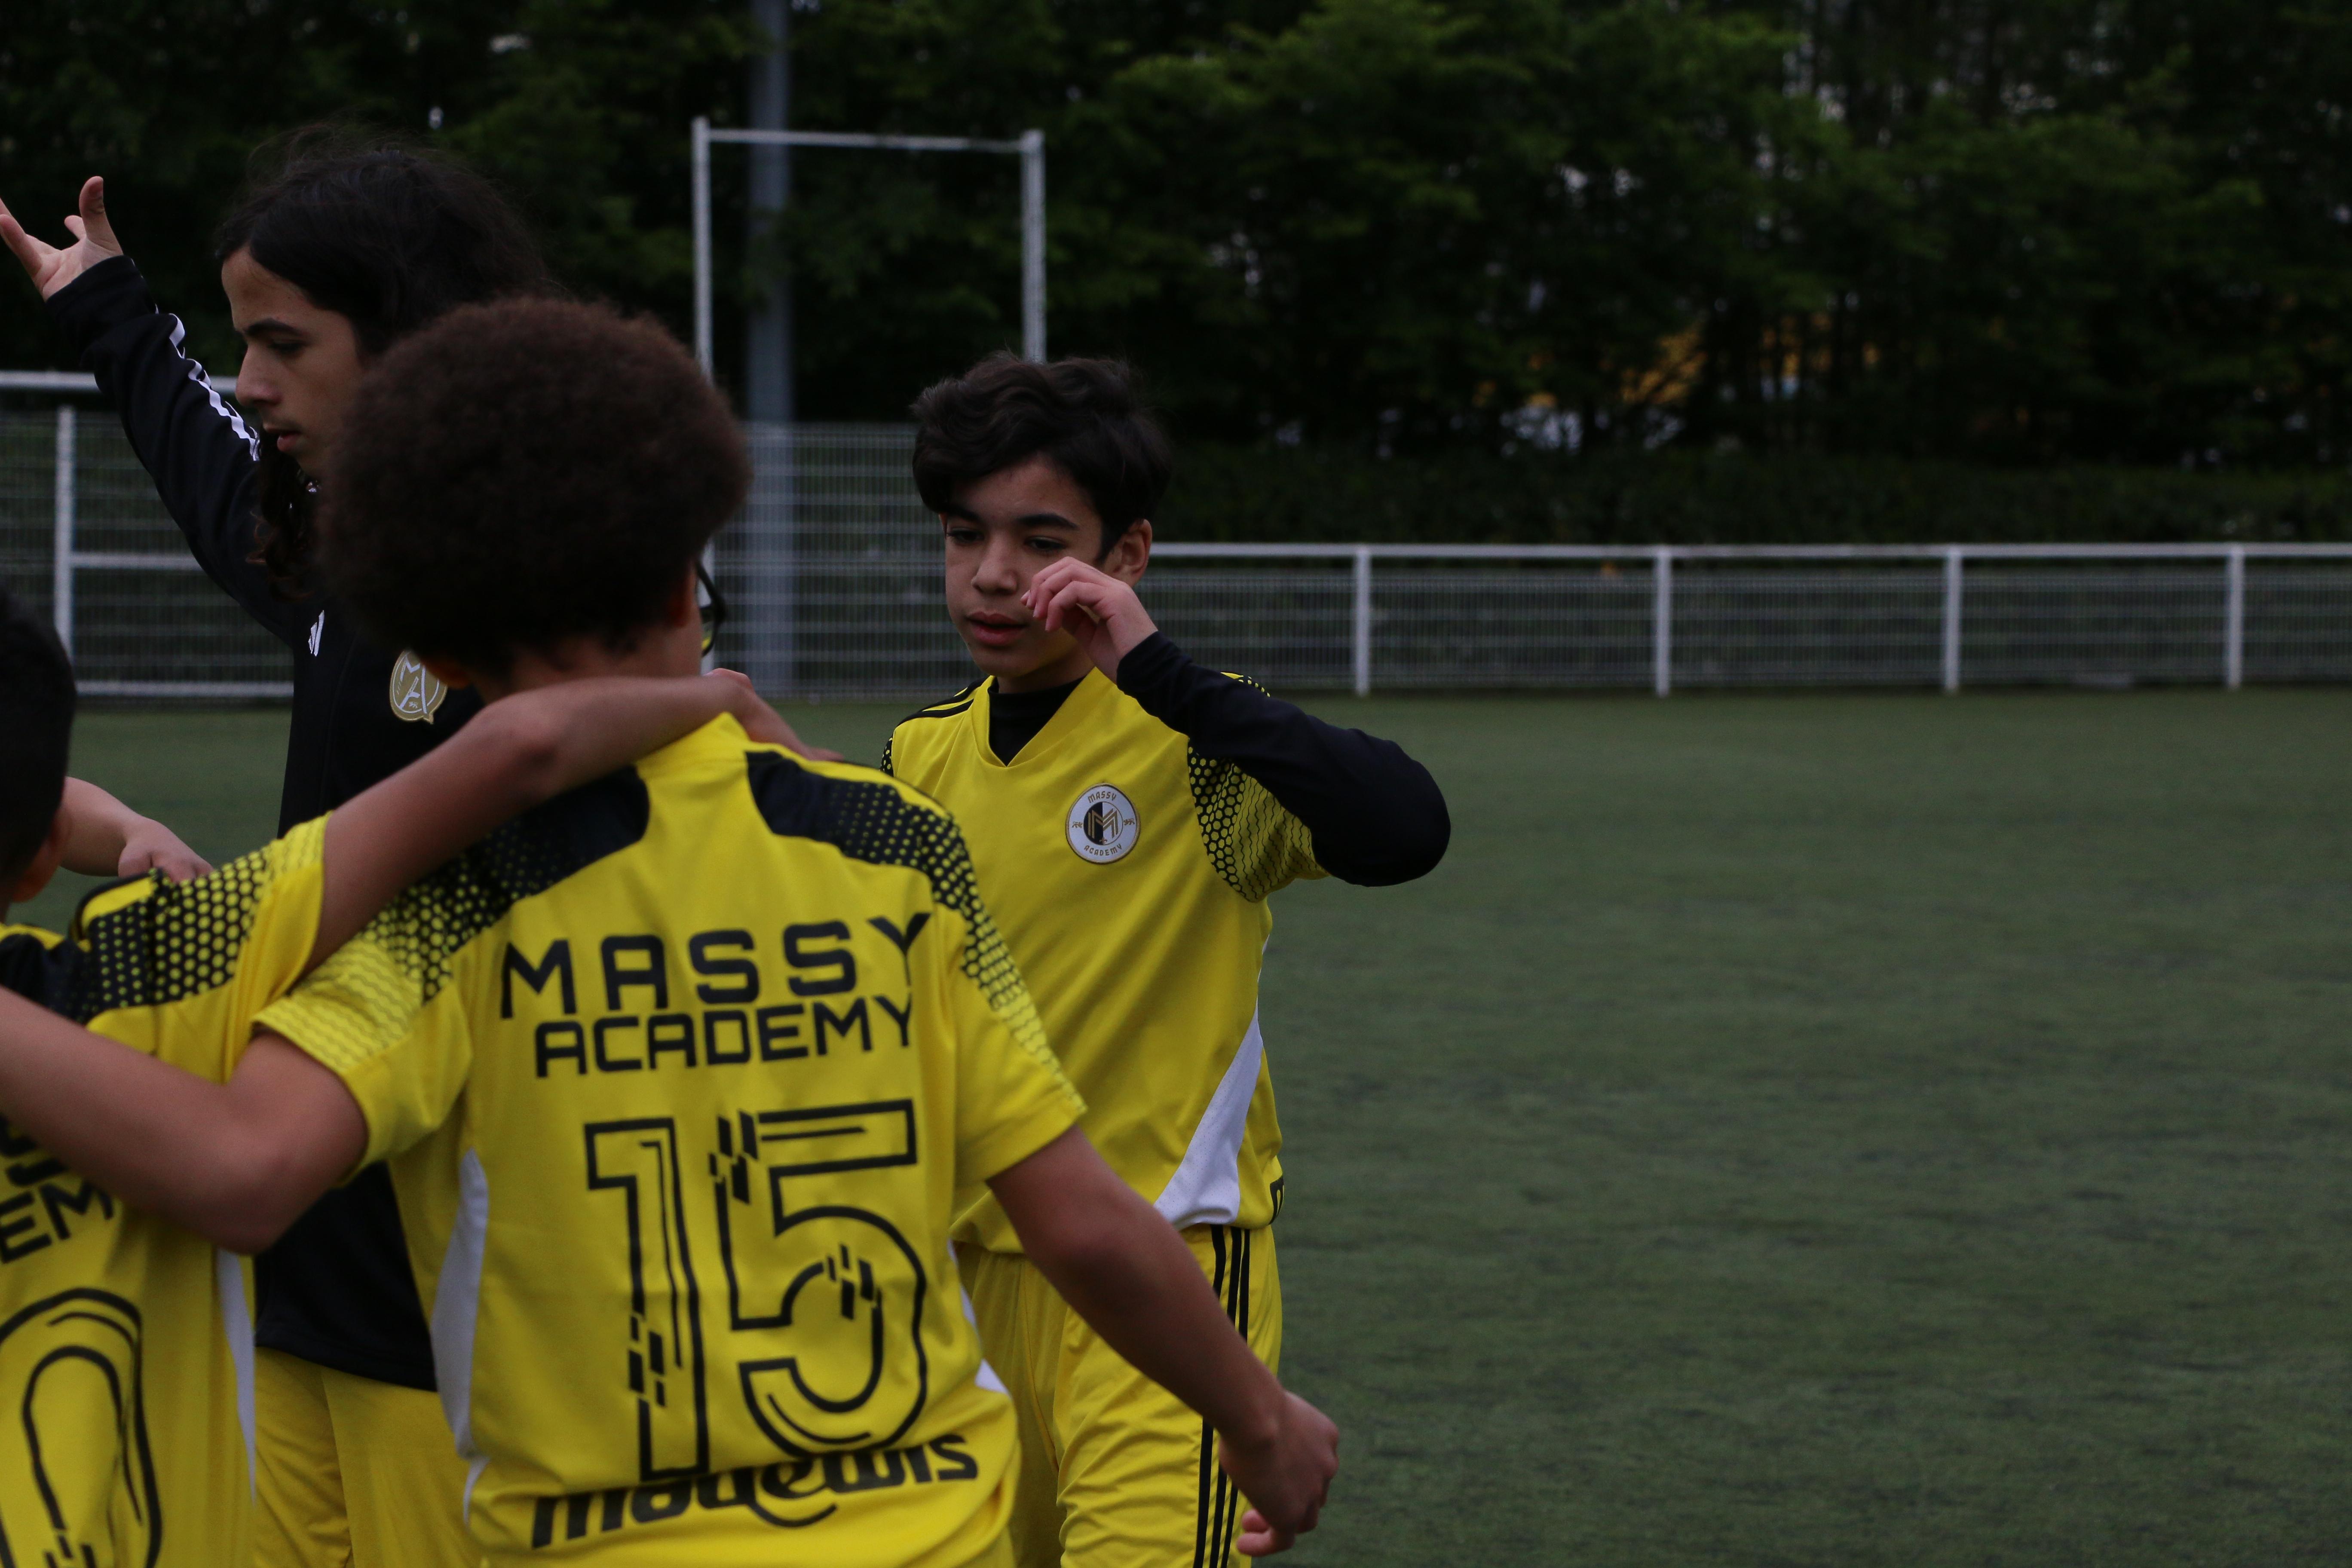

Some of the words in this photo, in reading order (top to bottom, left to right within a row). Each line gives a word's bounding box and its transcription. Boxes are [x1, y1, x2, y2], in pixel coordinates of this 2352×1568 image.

[1088, 791, 1117, 803] MASSY
[1084, 844, 1122, 856] ACADEMY
[501, 913, 931, 1019] MASSY
[536, 995, 912, 1078] ACADEMY
[585, 1099, 926, 1483] 15
